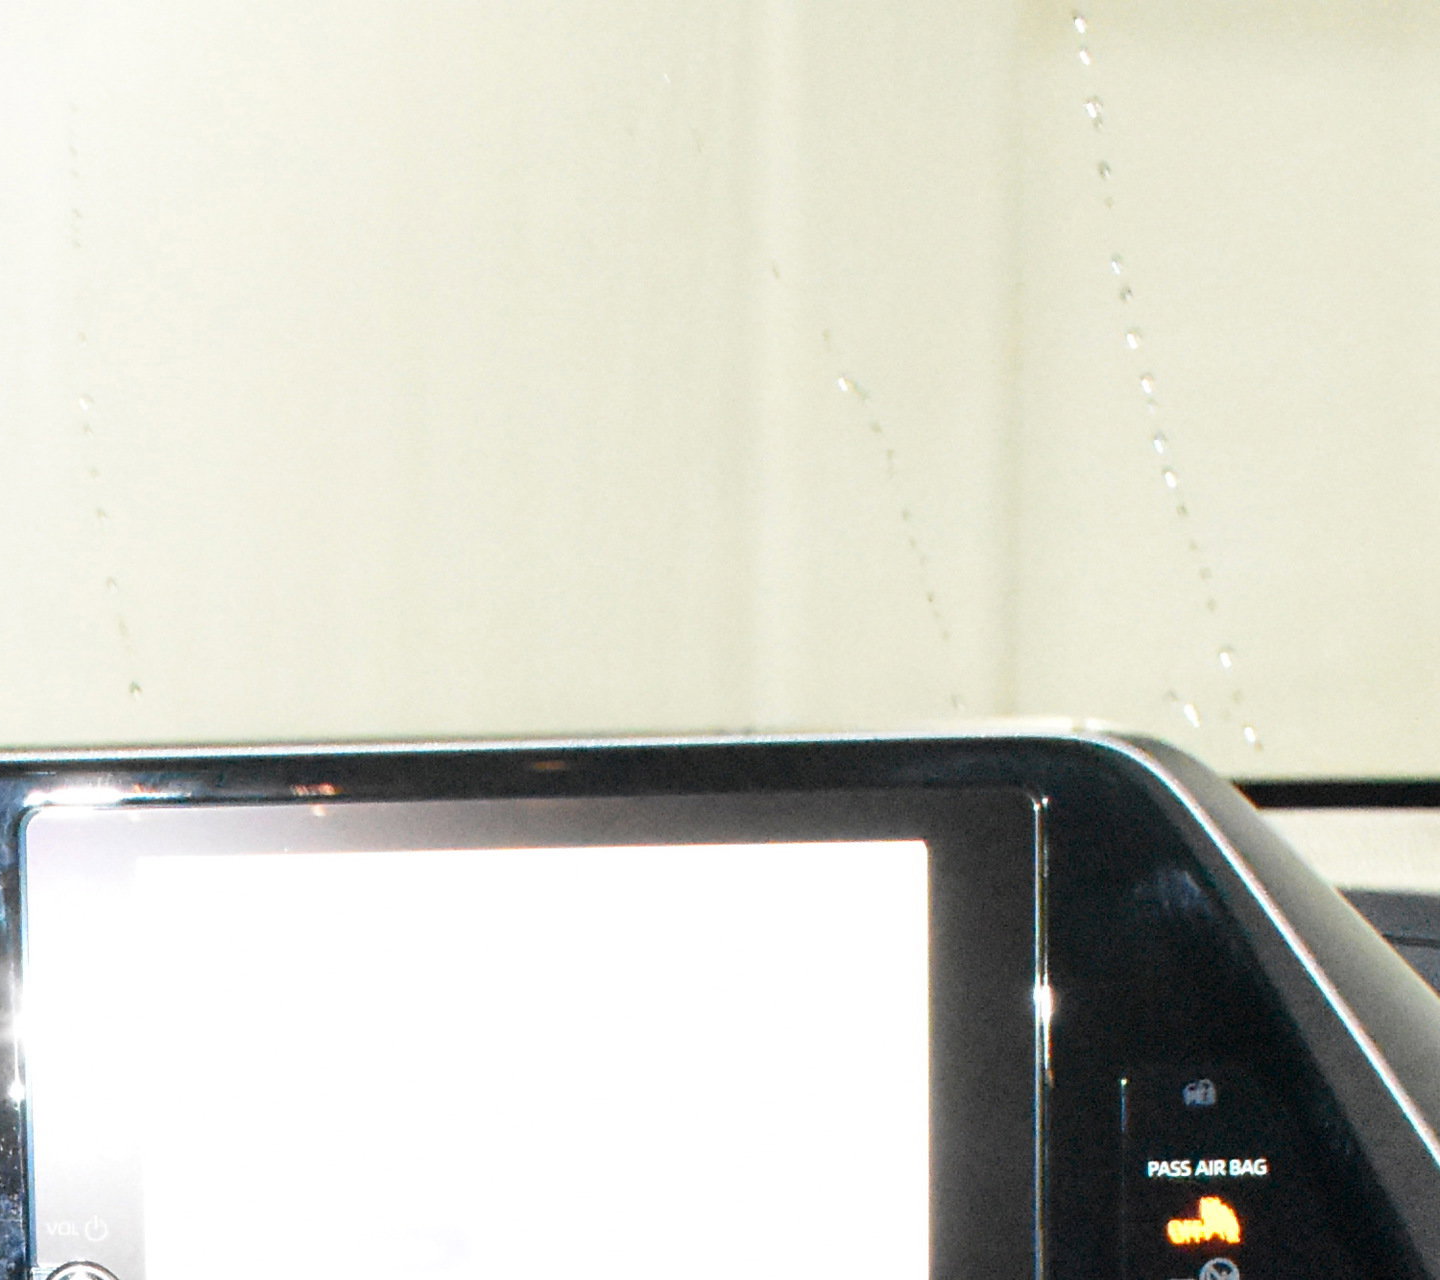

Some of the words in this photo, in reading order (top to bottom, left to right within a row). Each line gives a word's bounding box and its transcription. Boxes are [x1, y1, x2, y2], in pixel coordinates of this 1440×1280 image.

[1147, 1160, 1192, 1177] PASS
[1194, 1160, 1226, 1177] AIR
[1229, 1158, 1269, 1176] BAG
[46, 1222, 80, 1236] VOL
